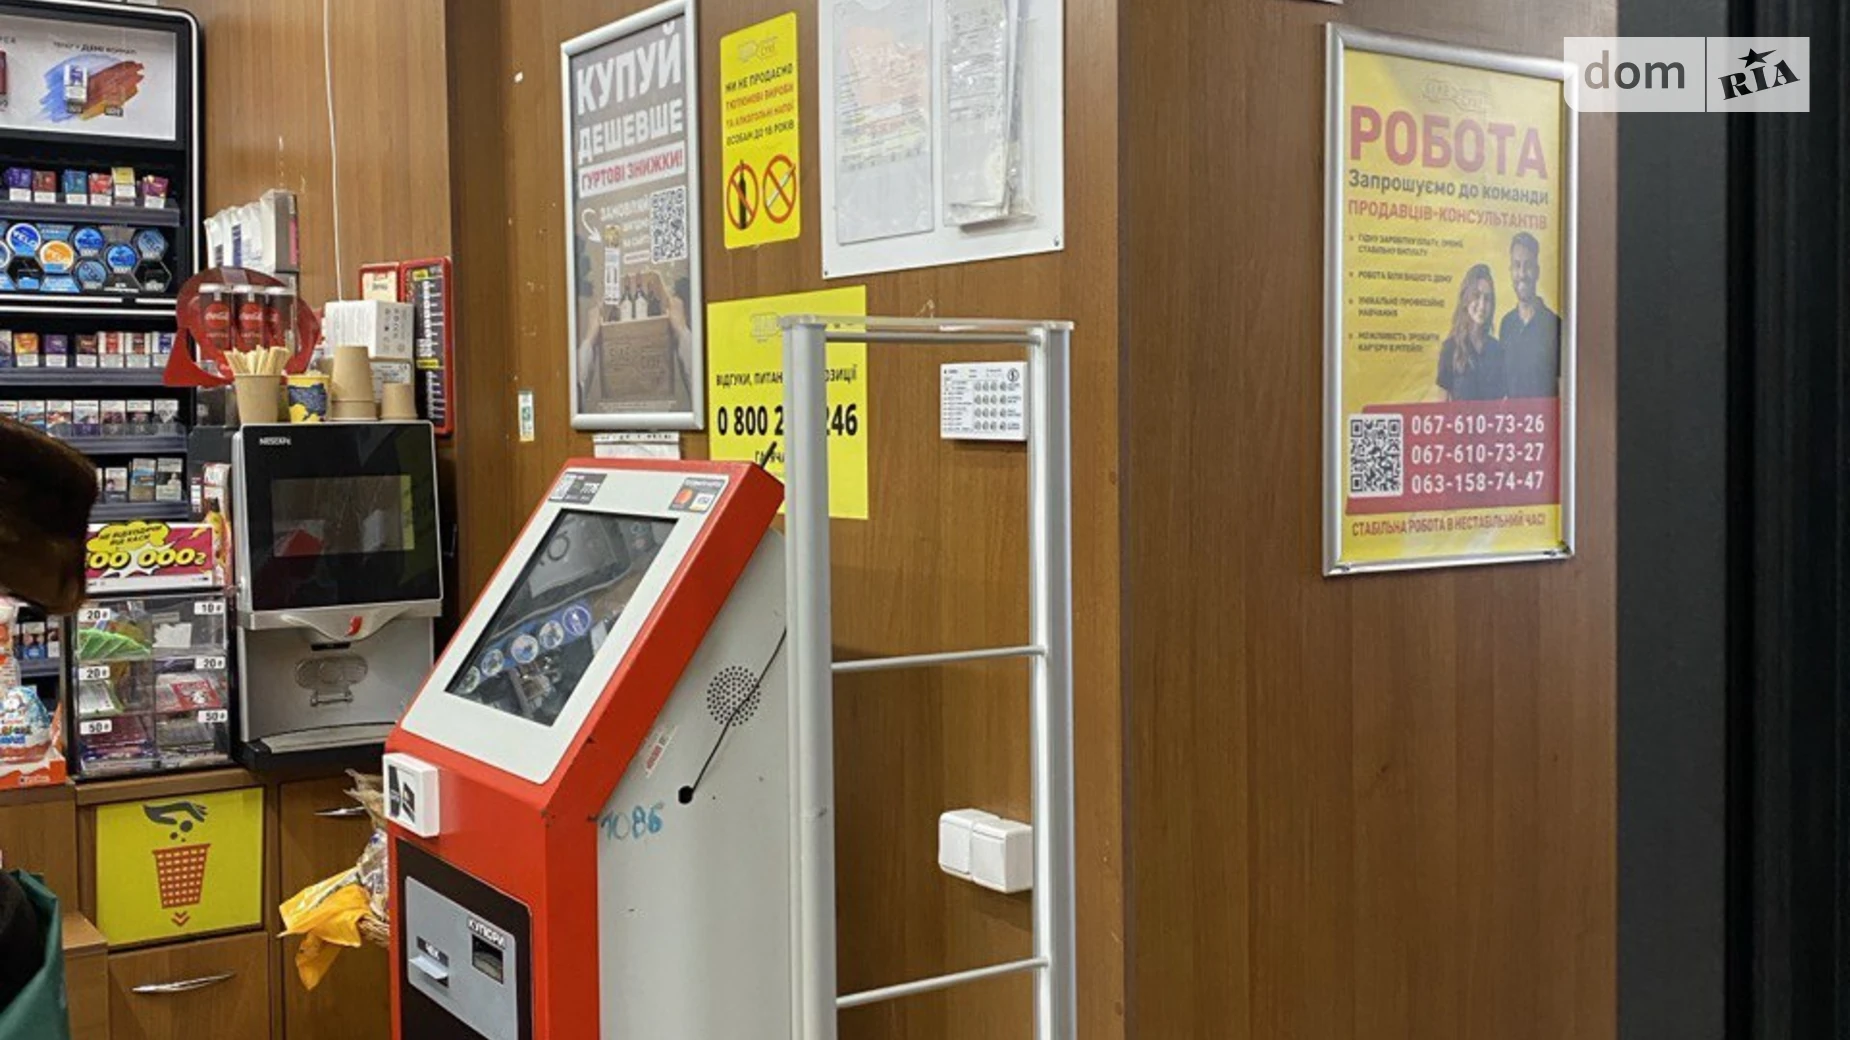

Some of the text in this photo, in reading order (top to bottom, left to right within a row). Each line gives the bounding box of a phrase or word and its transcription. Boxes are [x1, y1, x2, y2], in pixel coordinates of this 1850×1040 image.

[576, 22, 682, 116] КУПУЙ
[578, 99, 684, 166] ДЕШЕВШЕ
[1350, 105, 1549, 180] РОБОТА
[581, 148, 684, 192] ГУРТОВІ ЗНИЖКИ!
[1349, 169, 1549, 206] Запрошуємо до команди
[1348, 199, 1548, 231] ПРОДАВЦІВ-КОНСУЛЬТАНТІВ
[716, 364, 858, 389] ВІДГУКИ, ПИТАН ОЗИЦІЇ
[717, 403, 858, 436] 0 800 2 46
[1411, 414, 1545, 436] 067-610-73-26
[1411, 442, 1545, 465] 067-610-73-27
[1411, 471, 1545, 494] 063-158-74-47
[1352, 519, 1407, 537] СТАБІЛЬНА
[1408, 517, 1446, 534] РОБОТА
[1447, 516, 1454, 532] В
[1454, 510, 1526, 531] НЕСТАБІЛЬНИЙ
